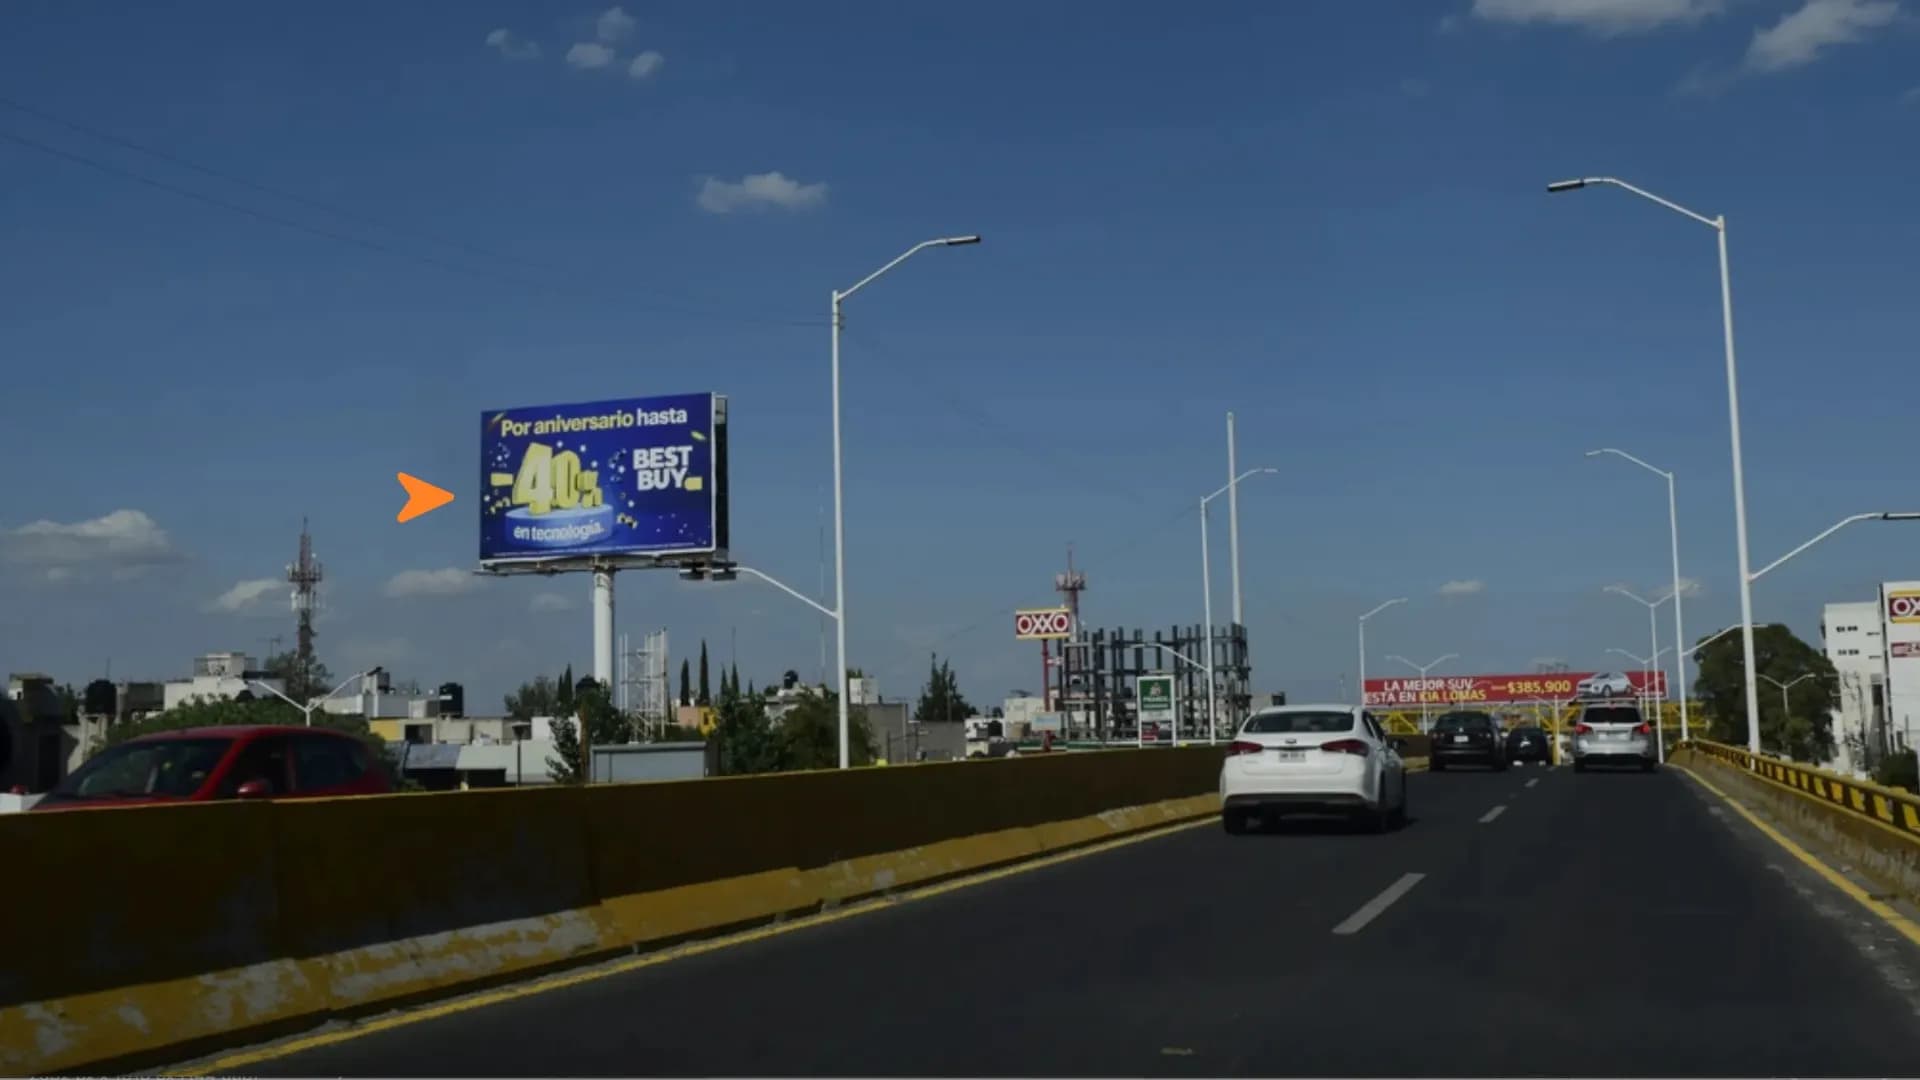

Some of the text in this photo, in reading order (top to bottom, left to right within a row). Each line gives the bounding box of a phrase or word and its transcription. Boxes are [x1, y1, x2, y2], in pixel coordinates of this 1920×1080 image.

[501, 408, 687, 437] Por aniversario hasta
[633, 445, 693, 470] BEST
[637, 467, 687, 491] BUY
[513, 526, 530, 540] en
[1017, 614, 1068, 634] OXXO
[1384, 678, 1474, 691] LA MEJOR SUV
[1507, 680, 1572, 695] $385,900
[1399, 691, 1416, 702] EN
[1419, 690, 1440, 701] KIA
[1442, 689, 1487, 701] LOMAS
